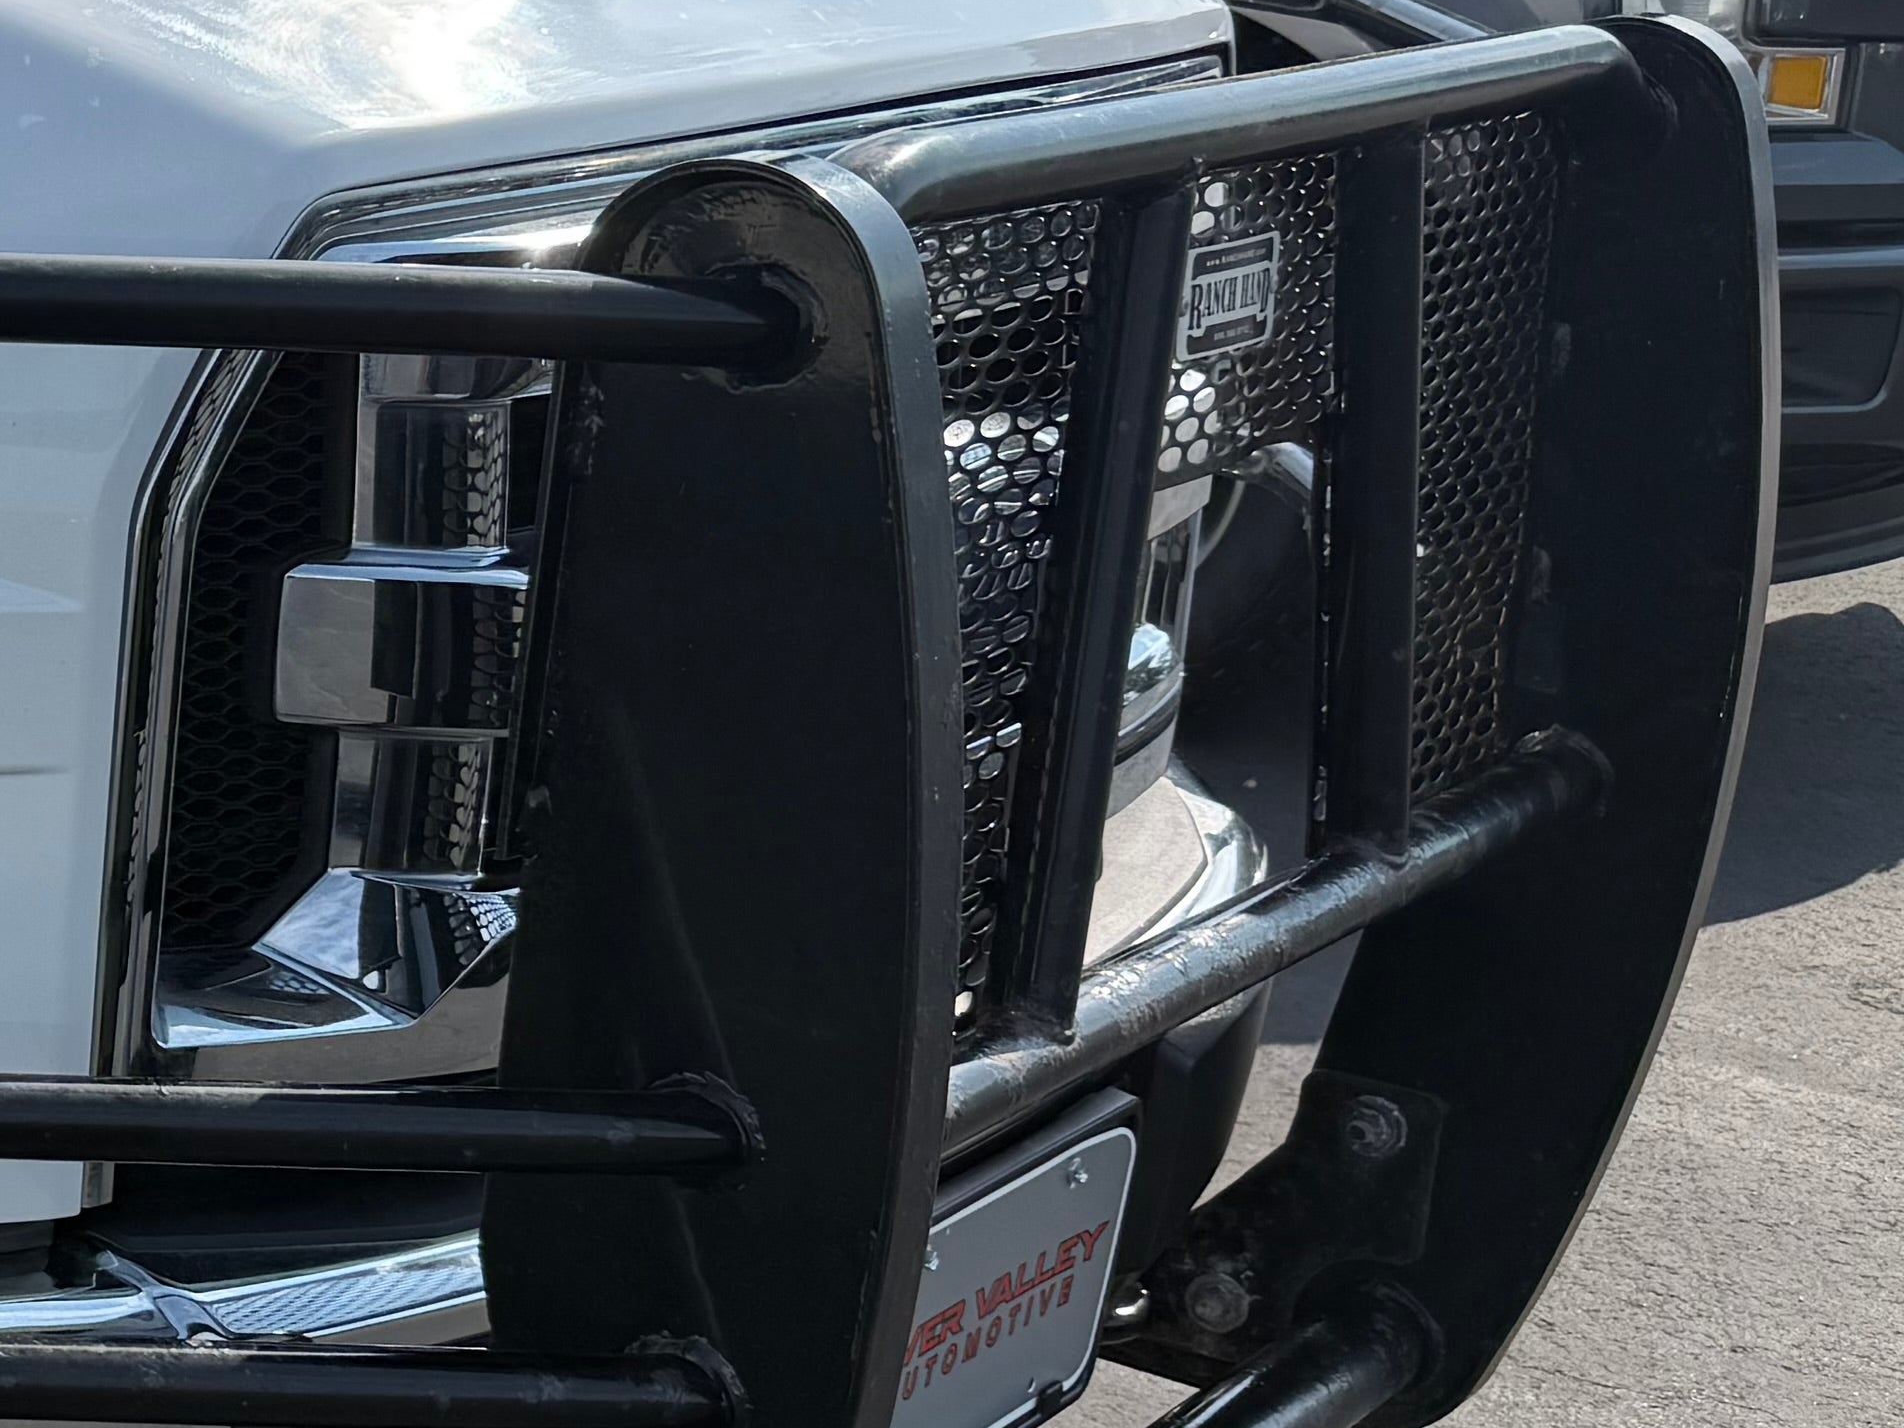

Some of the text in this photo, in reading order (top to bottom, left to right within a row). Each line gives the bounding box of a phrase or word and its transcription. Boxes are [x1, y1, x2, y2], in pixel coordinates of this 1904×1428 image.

[1188, 268, 1271, 331] RANCH HAND
[901, 1274, 1075, 1401] UTOMOTIVE
[903, 1219, 1111, 1367] VER VALLEY
